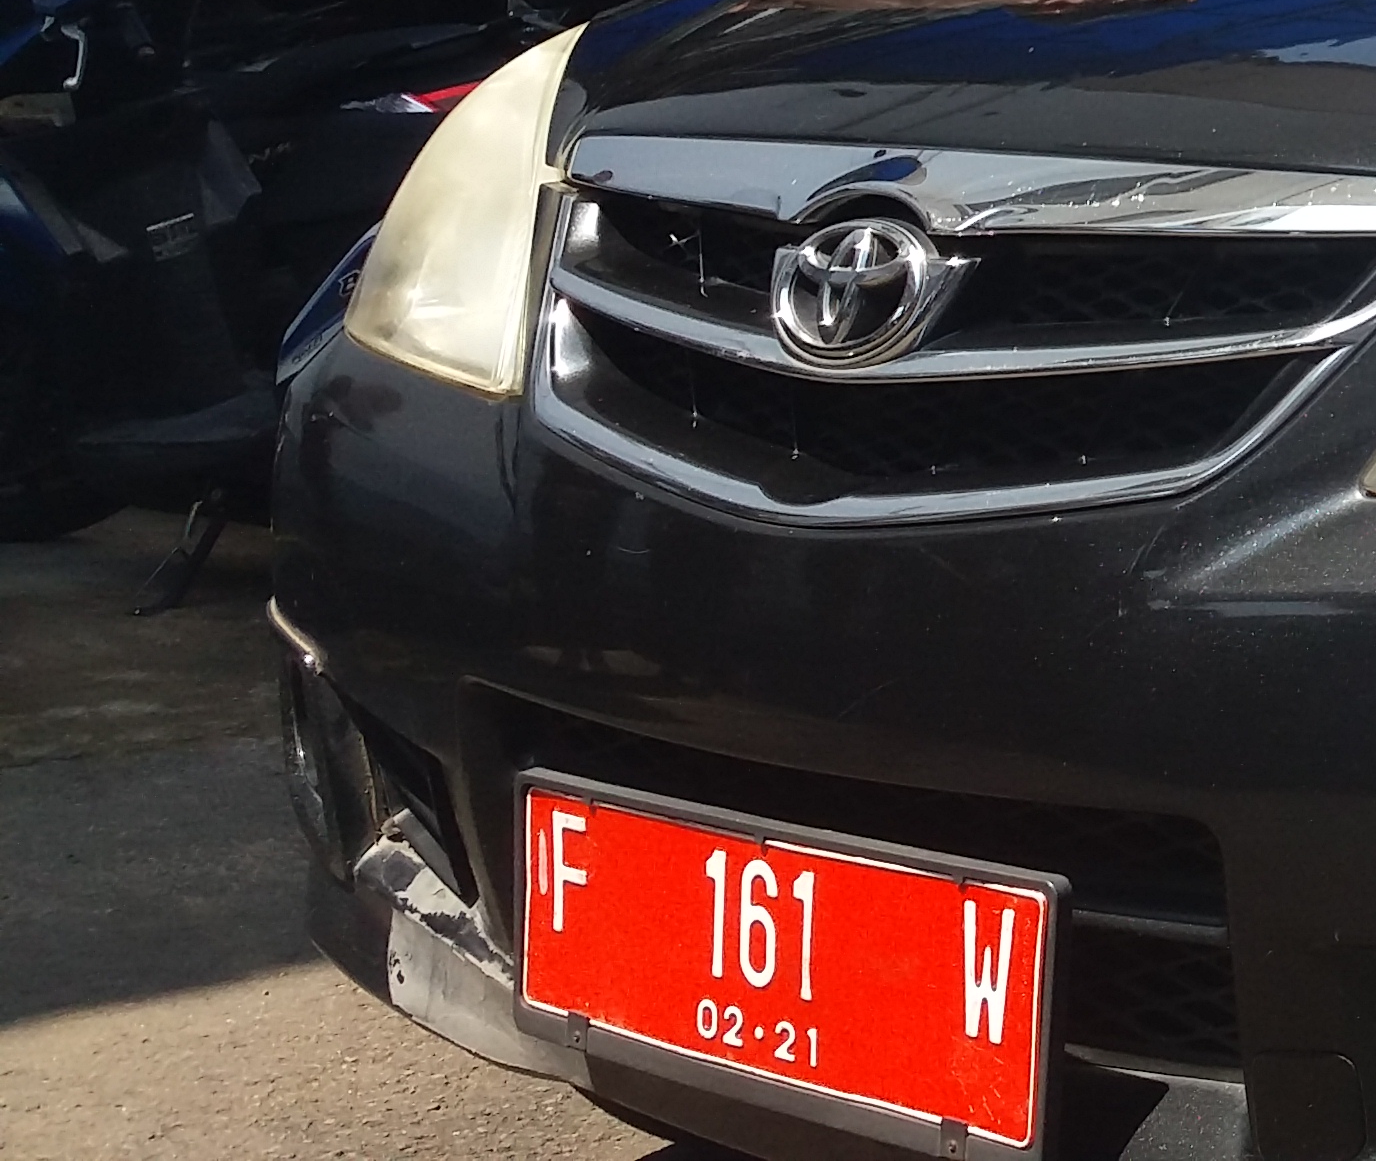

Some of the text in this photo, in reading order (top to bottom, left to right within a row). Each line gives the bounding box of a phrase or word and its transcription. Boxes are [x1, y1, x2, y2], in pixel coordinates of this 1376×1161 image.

[552, 810, 1016, 1046] F 161 W
